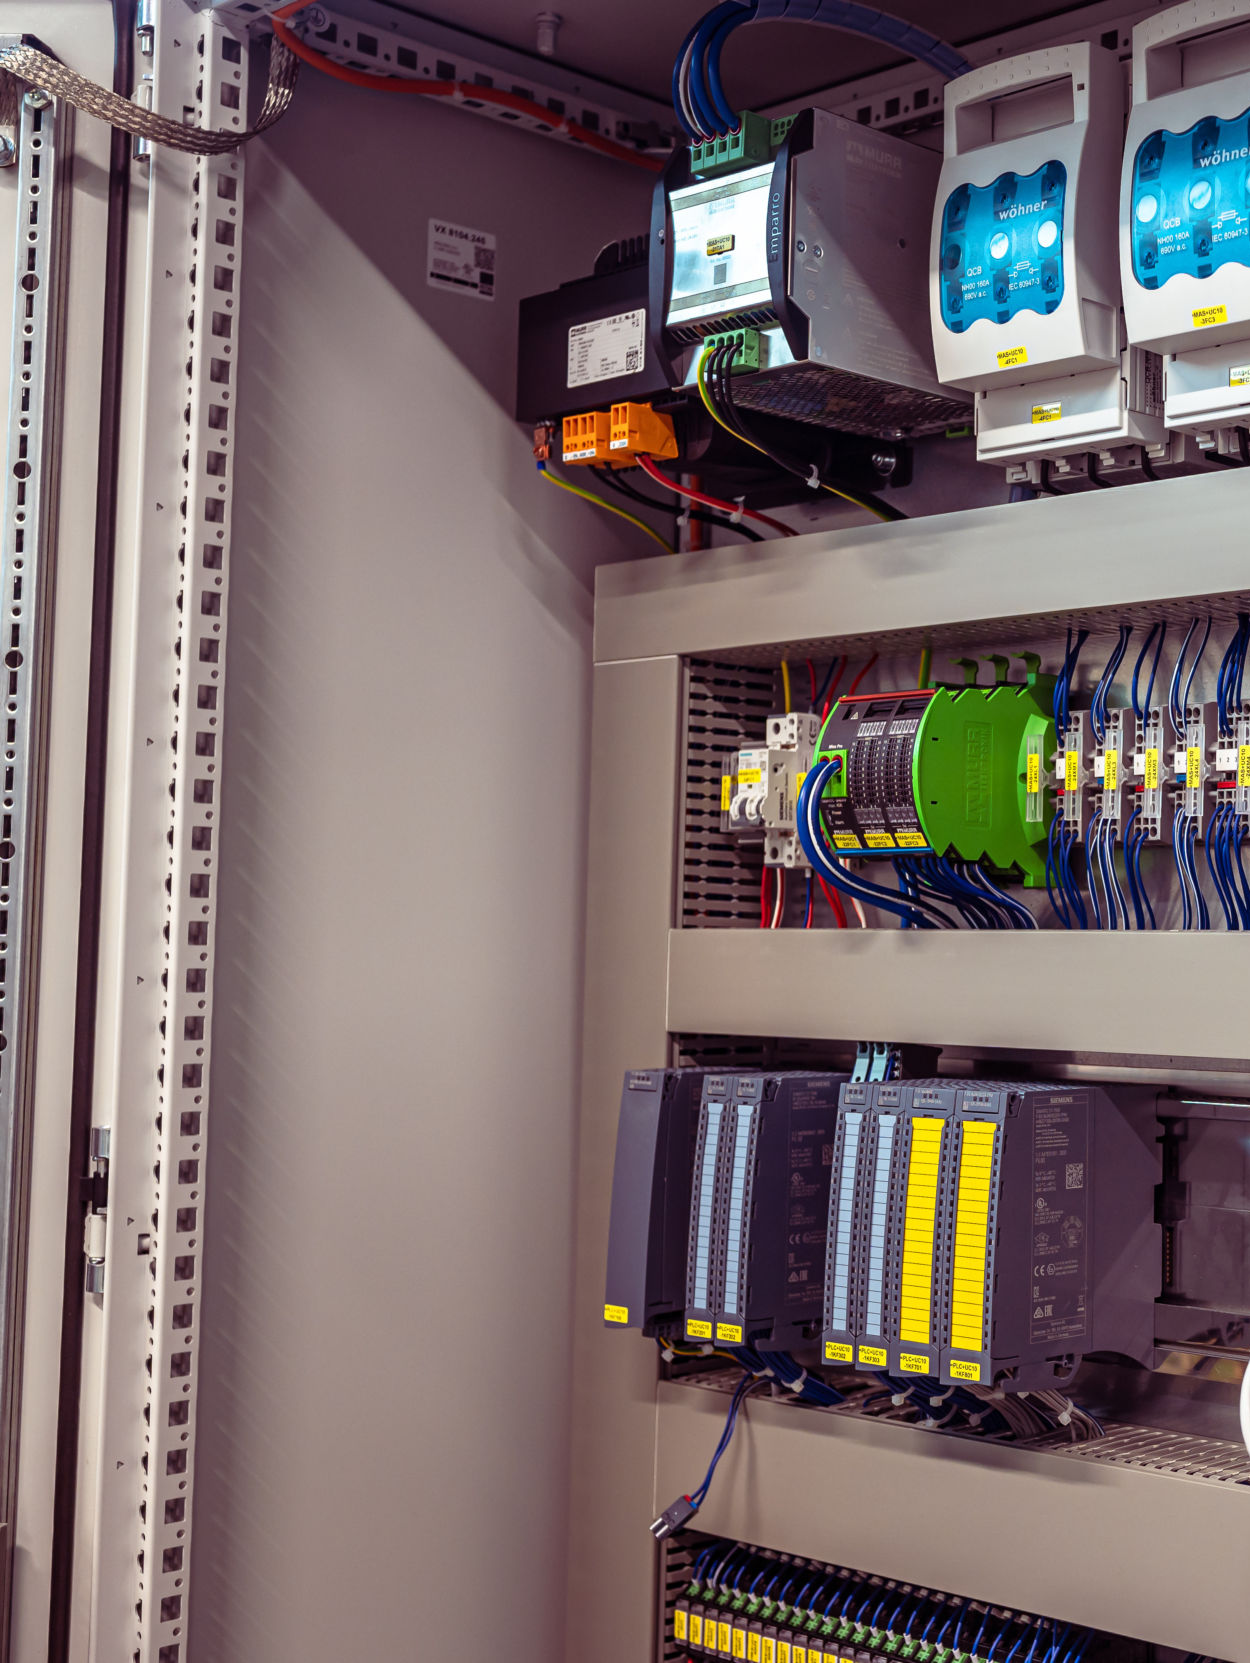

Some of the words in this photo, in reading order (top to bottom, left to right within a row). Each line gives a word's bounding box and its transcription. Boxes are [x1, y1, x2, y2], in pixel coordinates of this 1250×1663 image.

[999, 200, 1048, 220] wöhner
[768, 193, 782, 264] Emparro
[1163, 217, 1181, 230] QCB
[1157, 234, 1174, 245] NH00
[1175, 231, 1190, 243] 160A
[1211, 232, 1223, 243] IEC
[1223, 228, 1249, 241] 60947-3
[1160, 245, 1175, 255] 690V
[966, 266, 982, 277] QCB
[961, 281, 976, 292] NH00
[1008, 281, 1018, 291] IEC
[1034, 1264, 1045, 1277] CE
